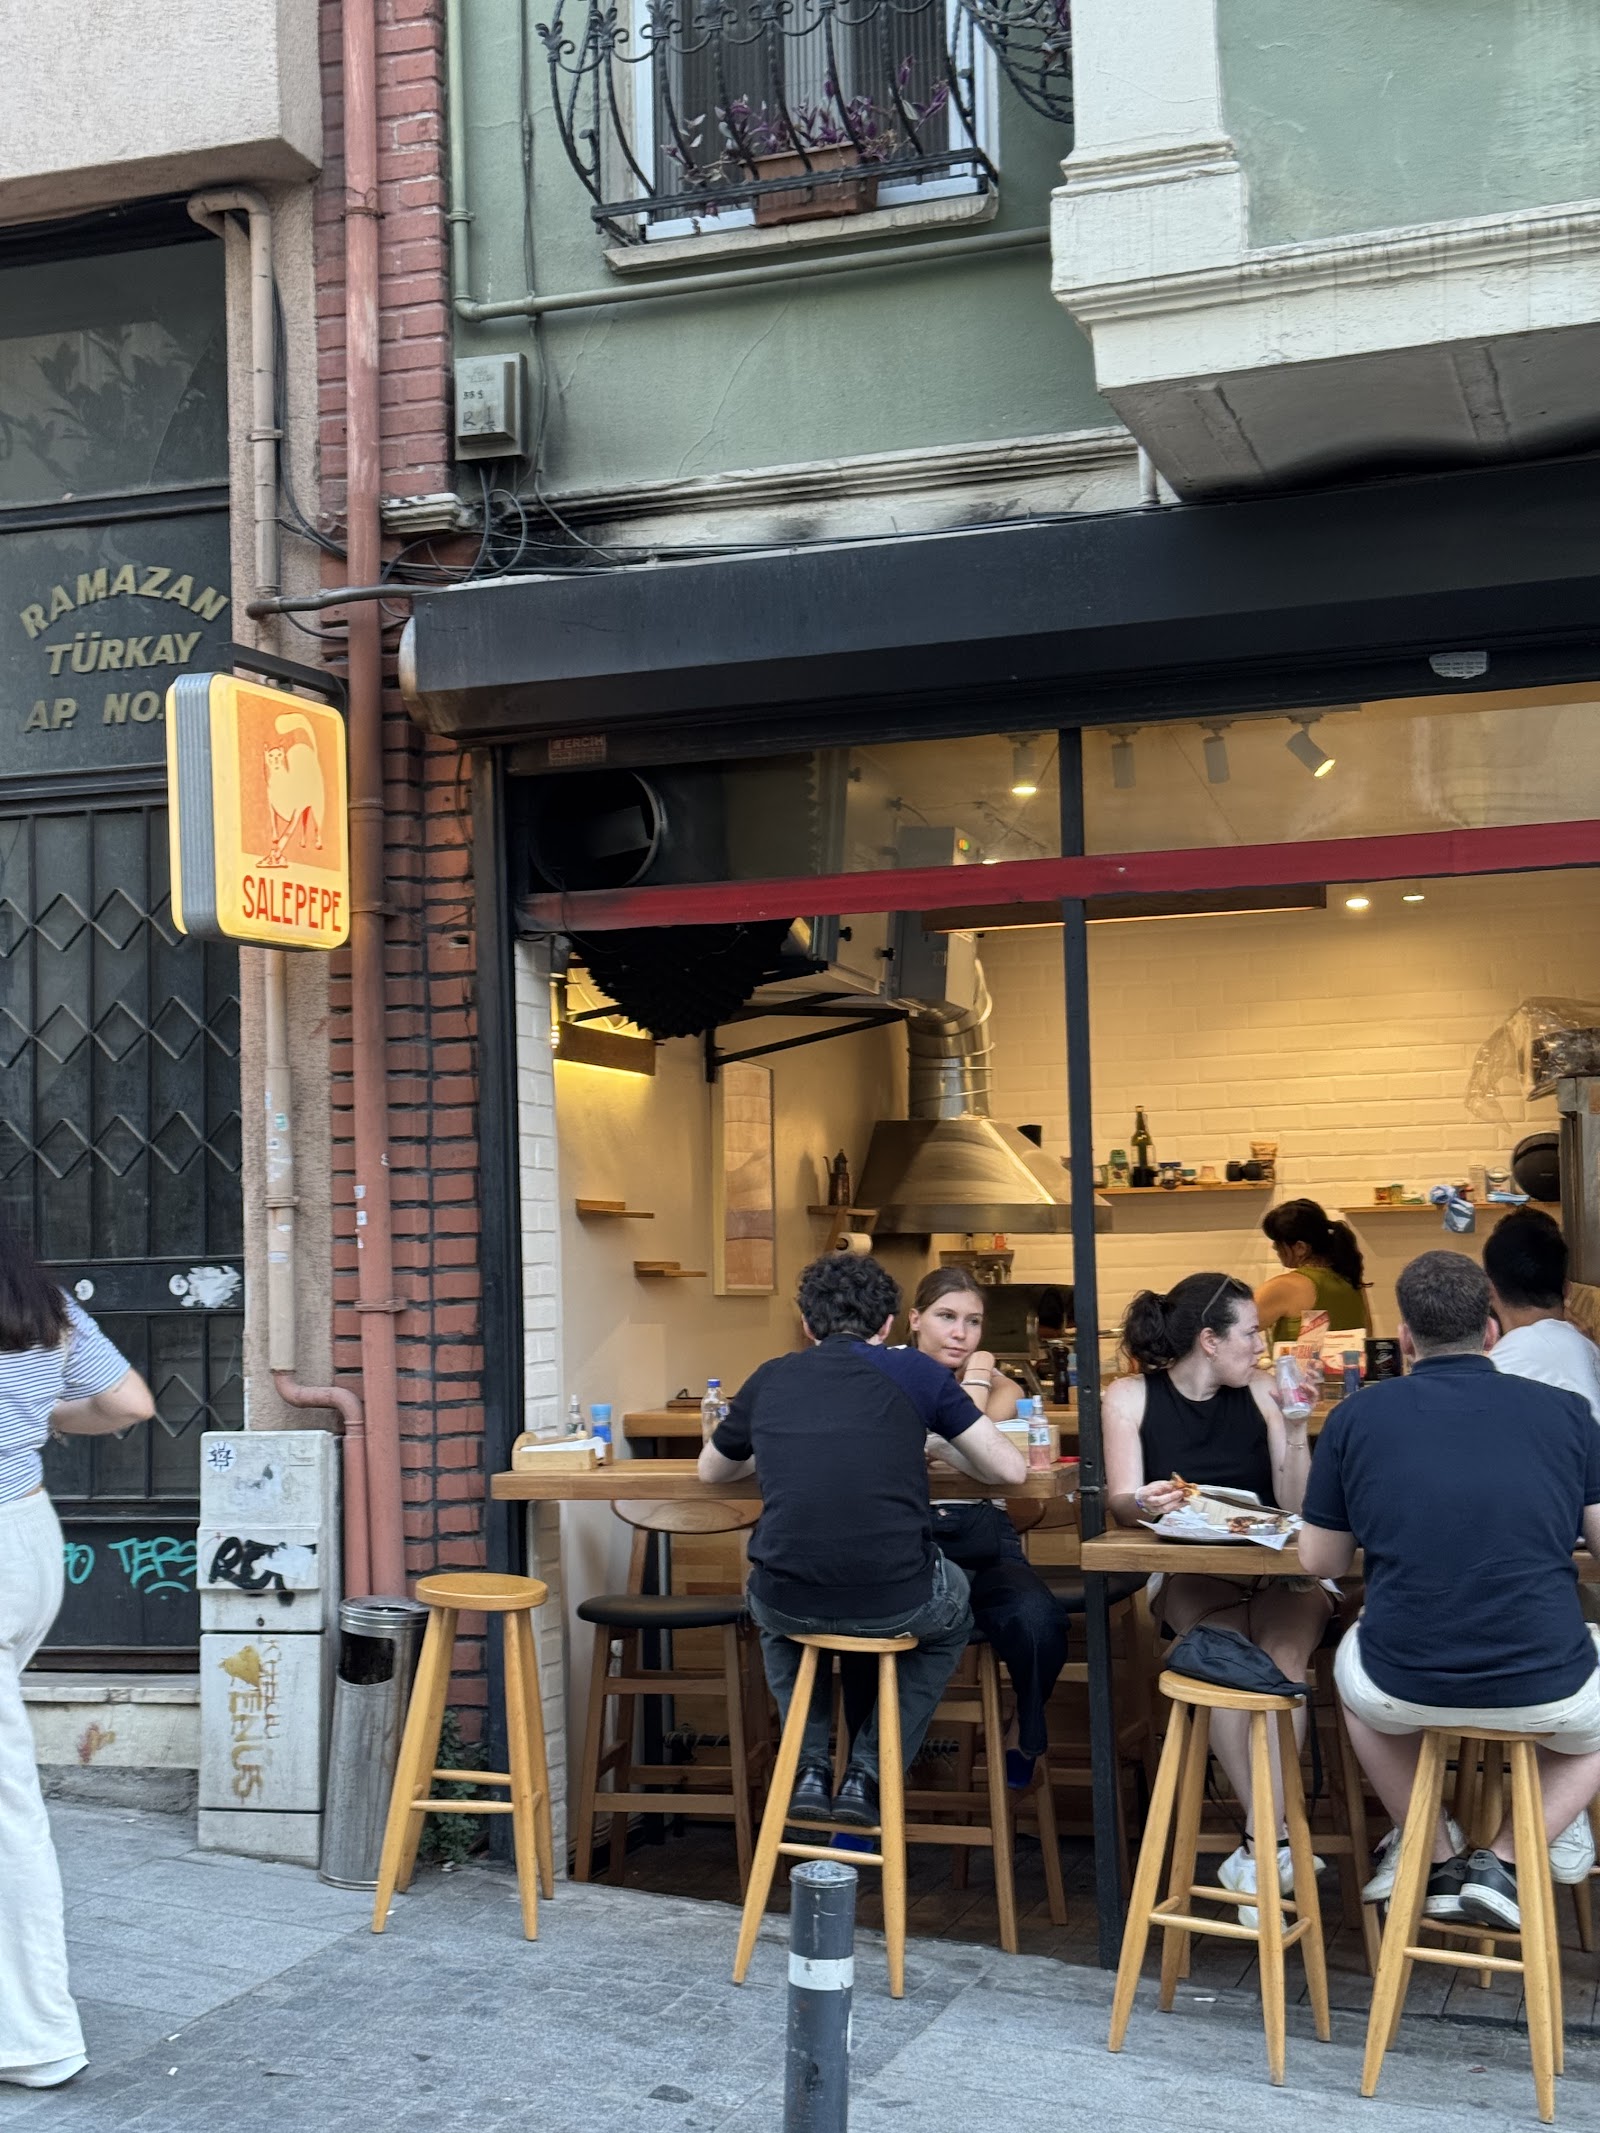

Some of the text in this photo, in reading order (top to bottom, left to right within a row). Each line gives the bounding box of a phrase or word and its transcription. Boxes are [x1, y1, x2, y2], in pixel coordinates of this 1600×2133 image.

[19, 564, 230, 640] RAMAZAN
[45, 631, 202, 674] TÜRKAY
[22, 698, 78, 733] AP.
[242, 874, 342, 933] SALEPEPE
